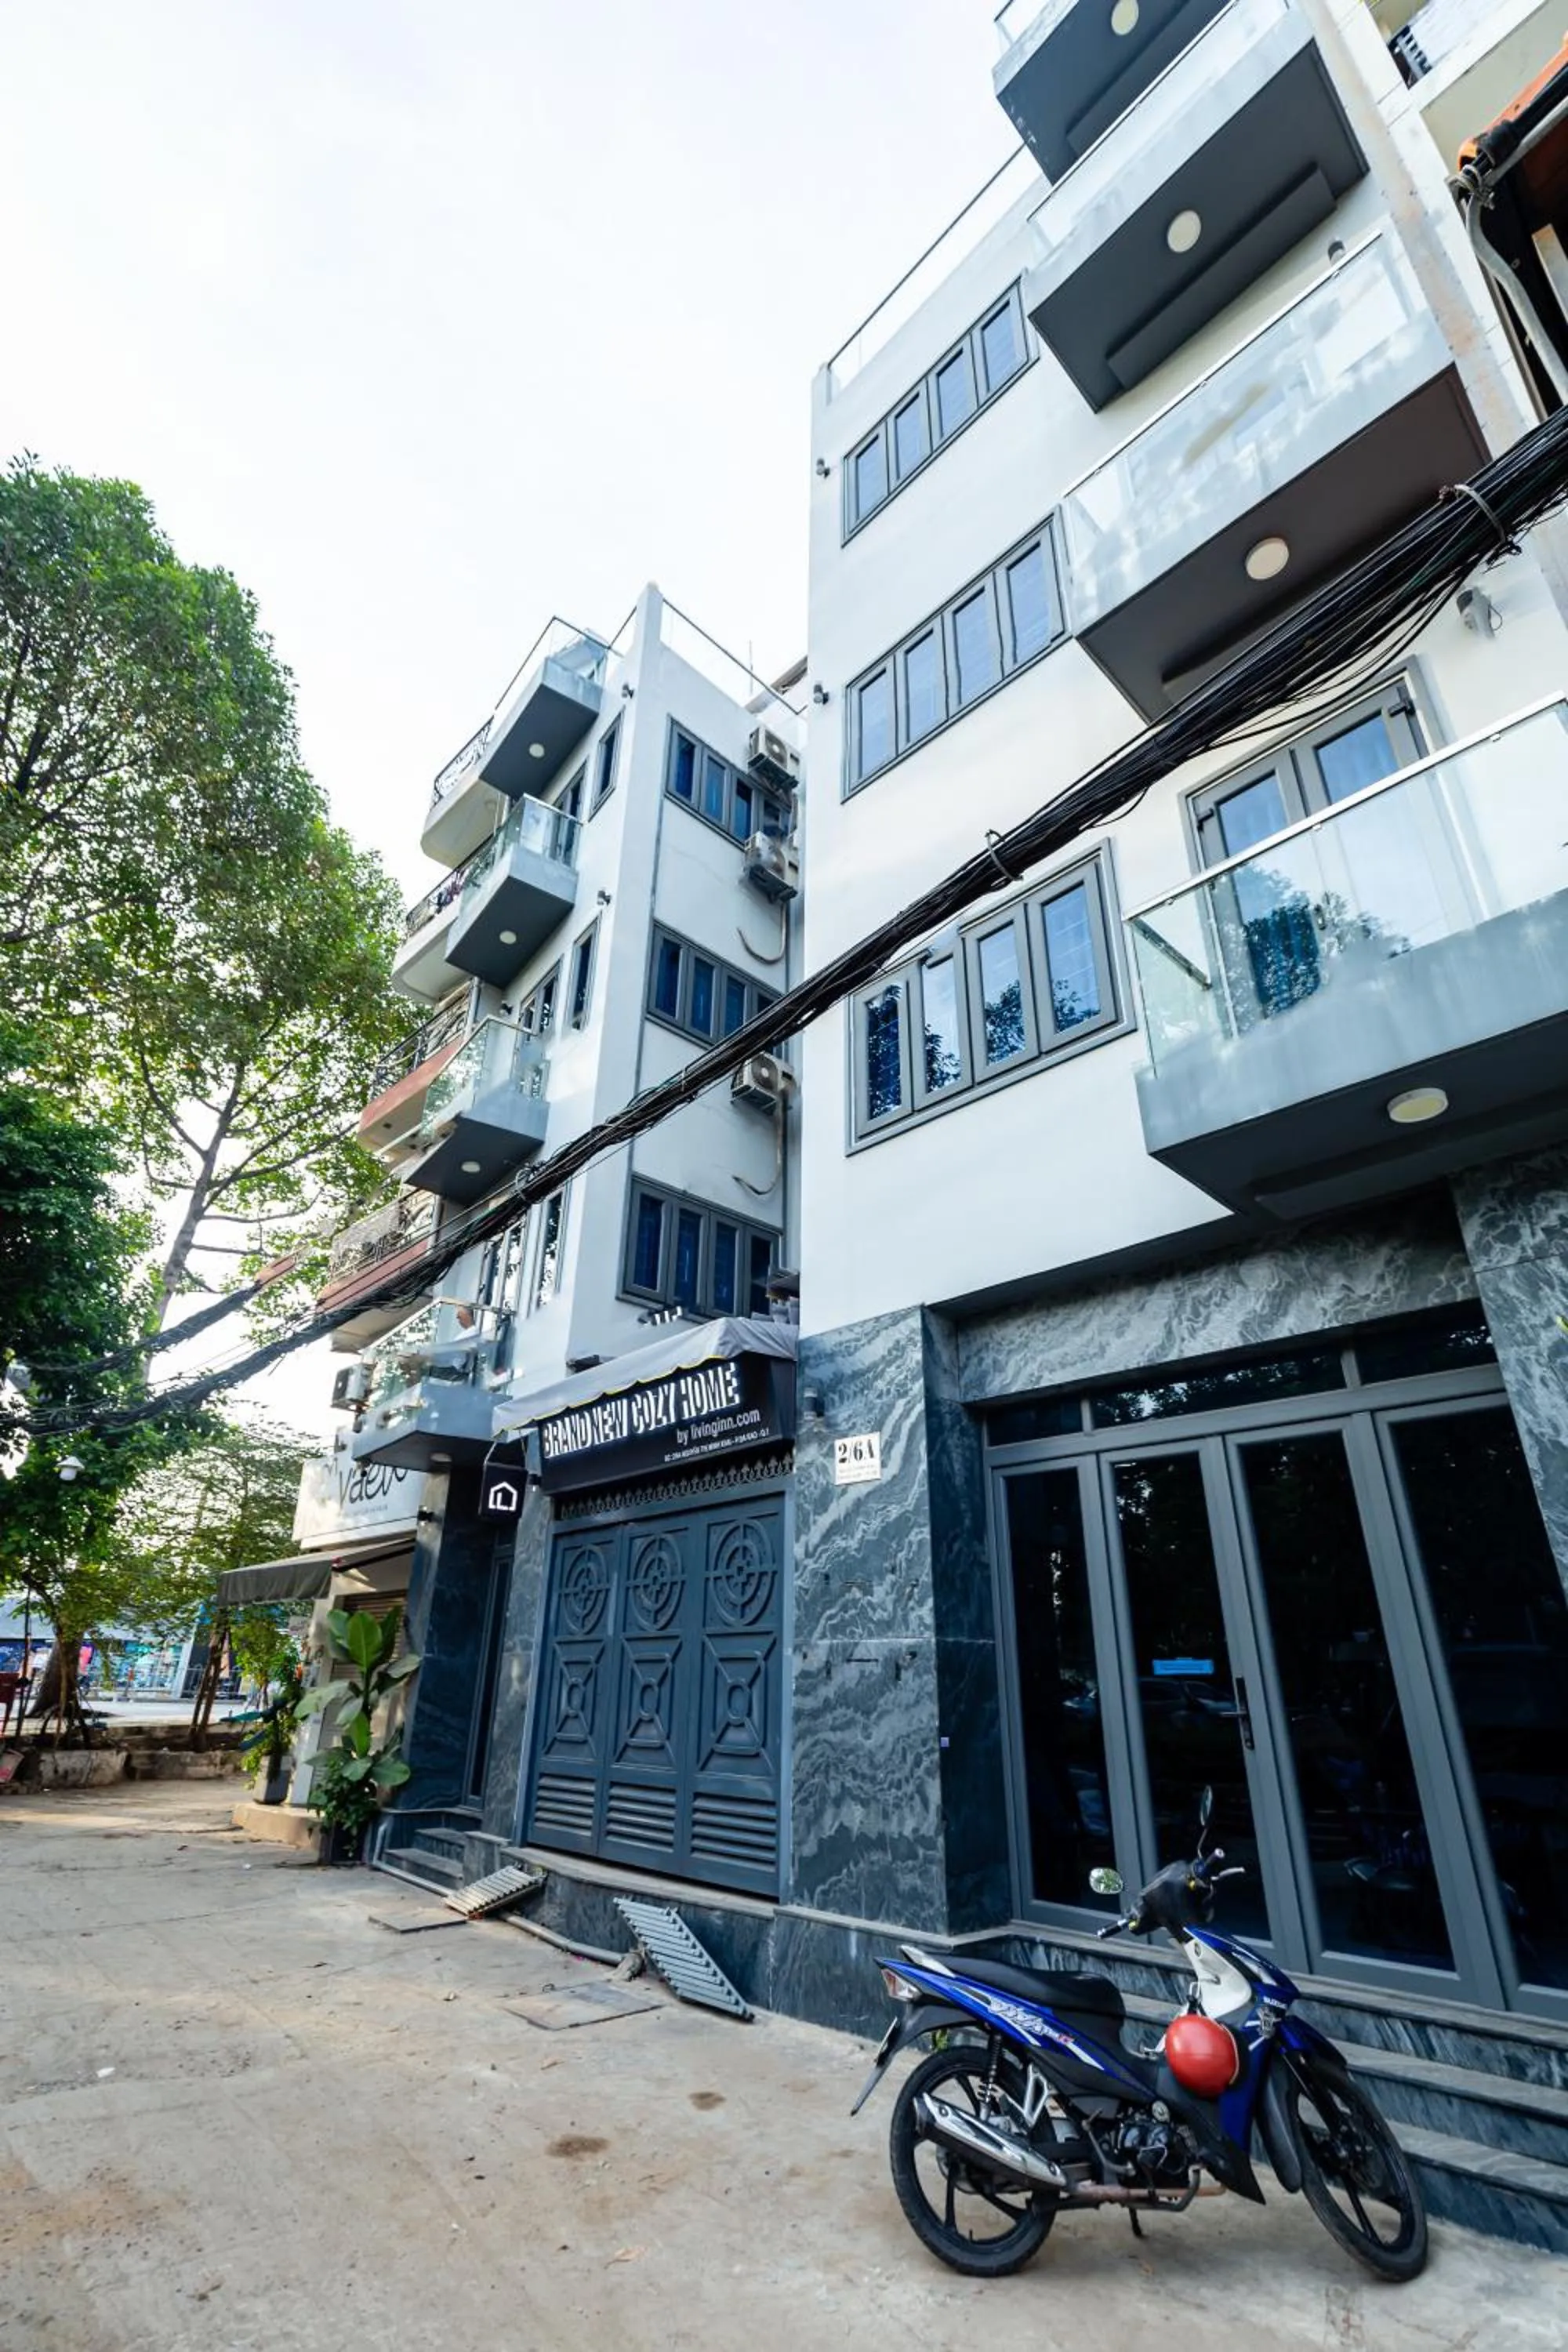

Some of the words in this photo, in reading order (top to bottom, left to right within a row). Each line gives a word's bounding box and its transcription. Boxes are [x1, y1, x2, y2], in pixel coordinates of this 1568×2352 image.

[630, 1382, 676, 1434] COZY
[679, 1362, 740, 1420] HOME
[677, 1428, 689, 1446] by
[691, 1409, 761, 1440] livinginn.com
